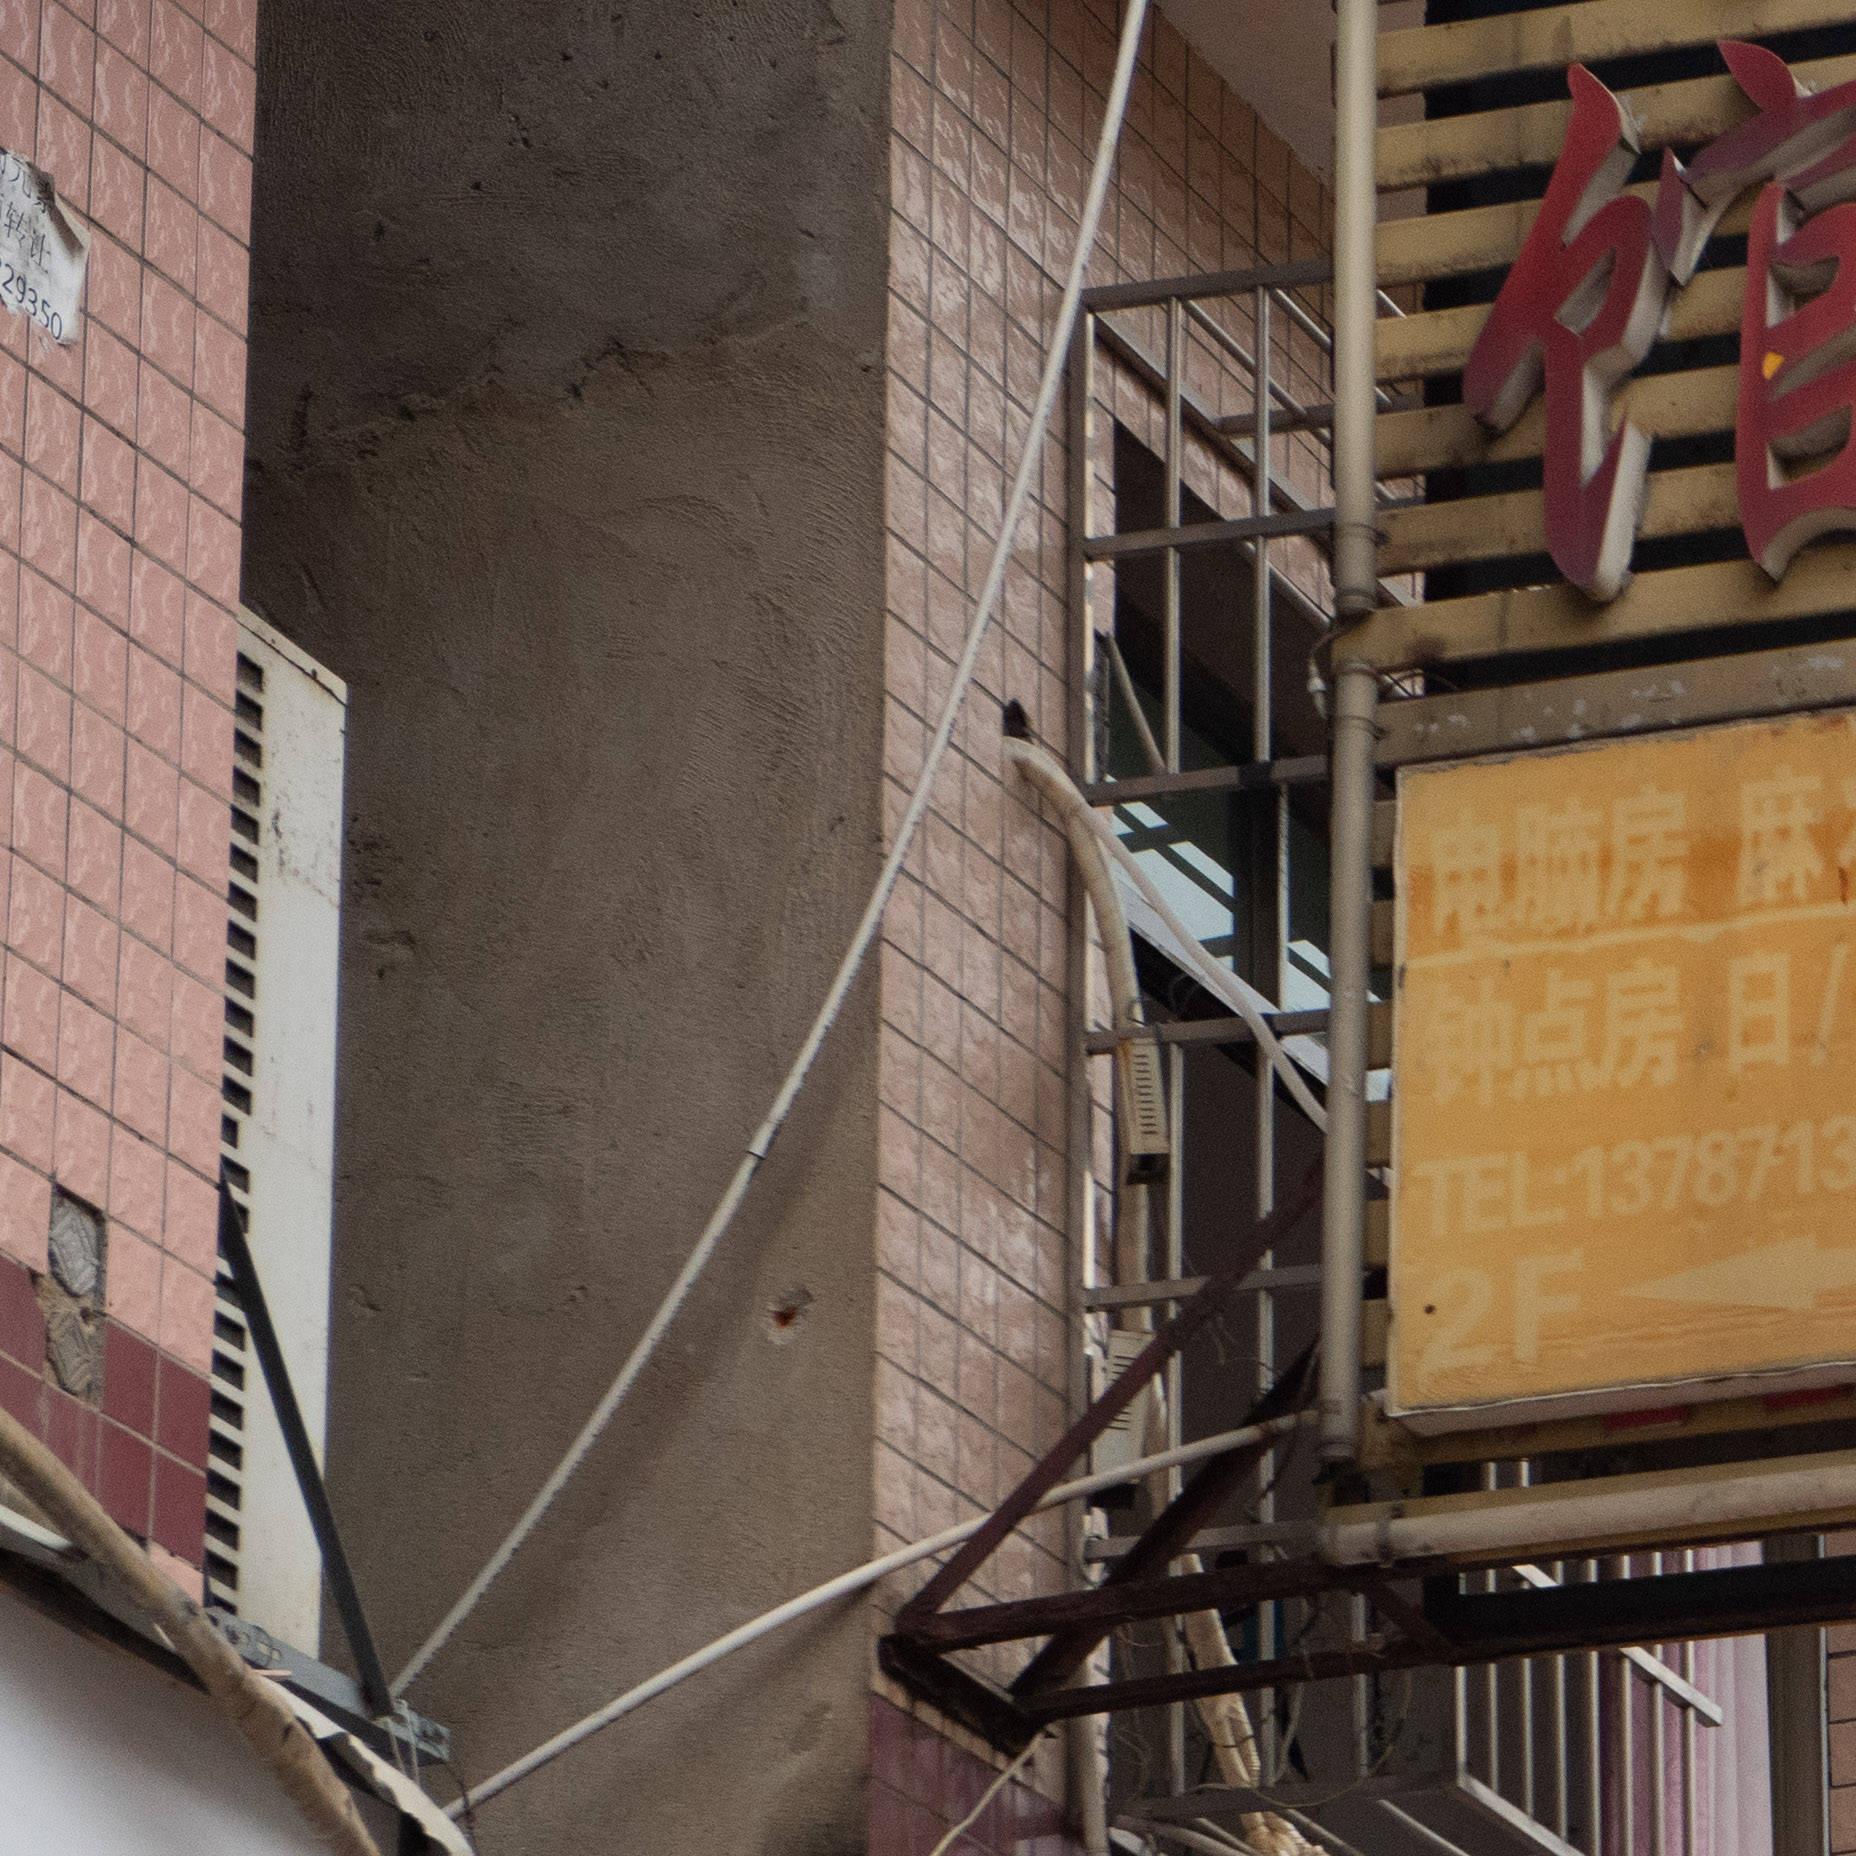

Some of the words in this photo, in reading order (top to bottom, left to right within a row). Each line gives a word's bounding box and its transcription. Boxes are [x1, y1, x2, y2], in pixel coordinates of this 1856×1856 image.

[0, 257, 63, 341] 29350
[1424, 957, 1684, 1108] 钟点房
[1418, 1247, 1585, 1380] 2F
